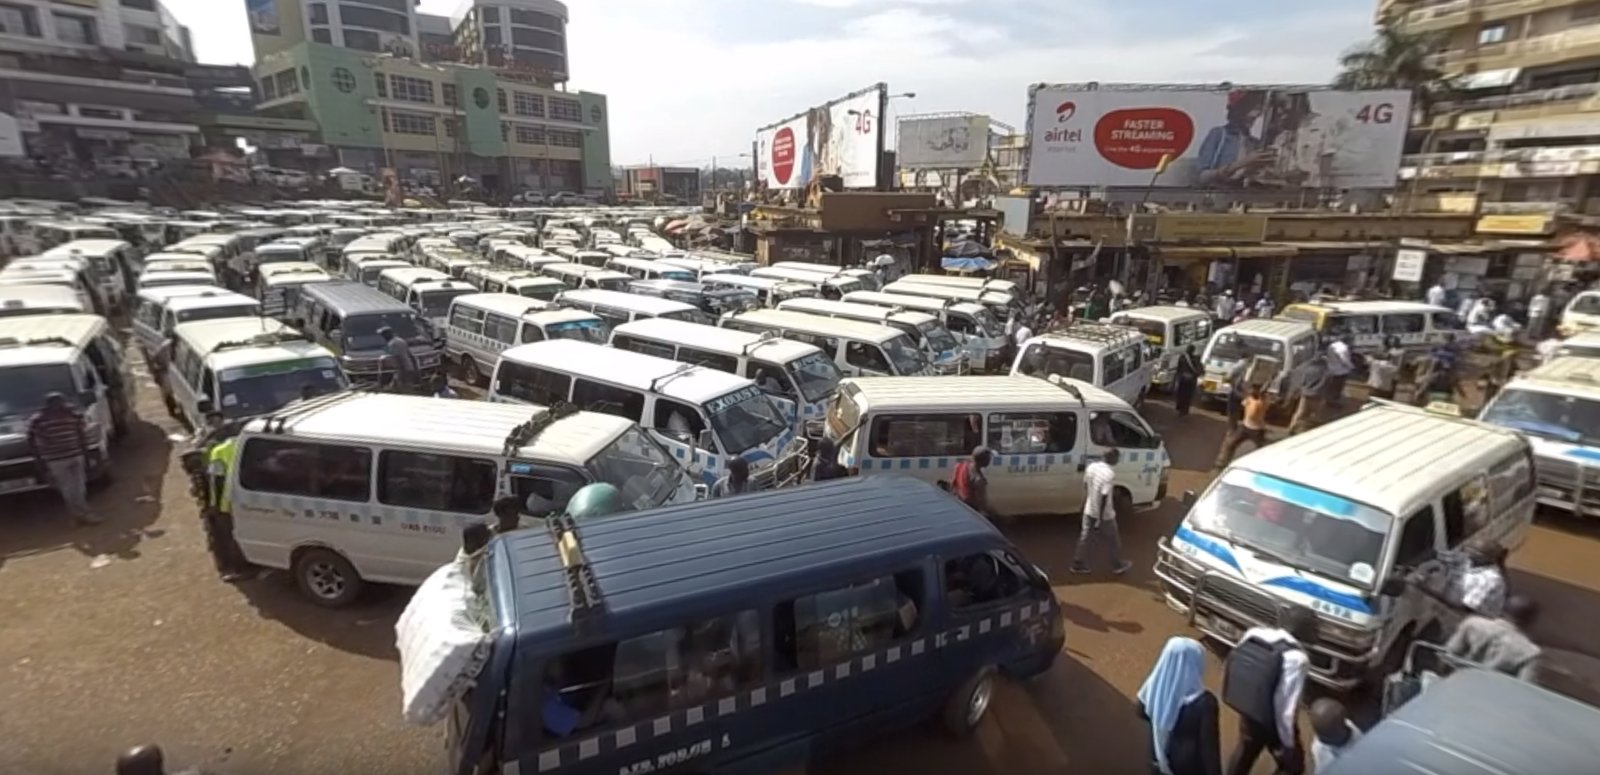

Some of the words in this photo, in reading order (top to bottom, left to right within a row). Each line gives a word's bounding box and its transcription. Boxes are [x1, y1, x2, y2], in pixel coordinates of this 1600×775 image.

[1356, 103, 1394, 124] 4G
[855, 109, 871, 135] 4G
[1124, 120, 1165, 129] FASTER
[1045, 127, 1082, 142] airtel
[1111, 130, 1174, 140] STREAMING
